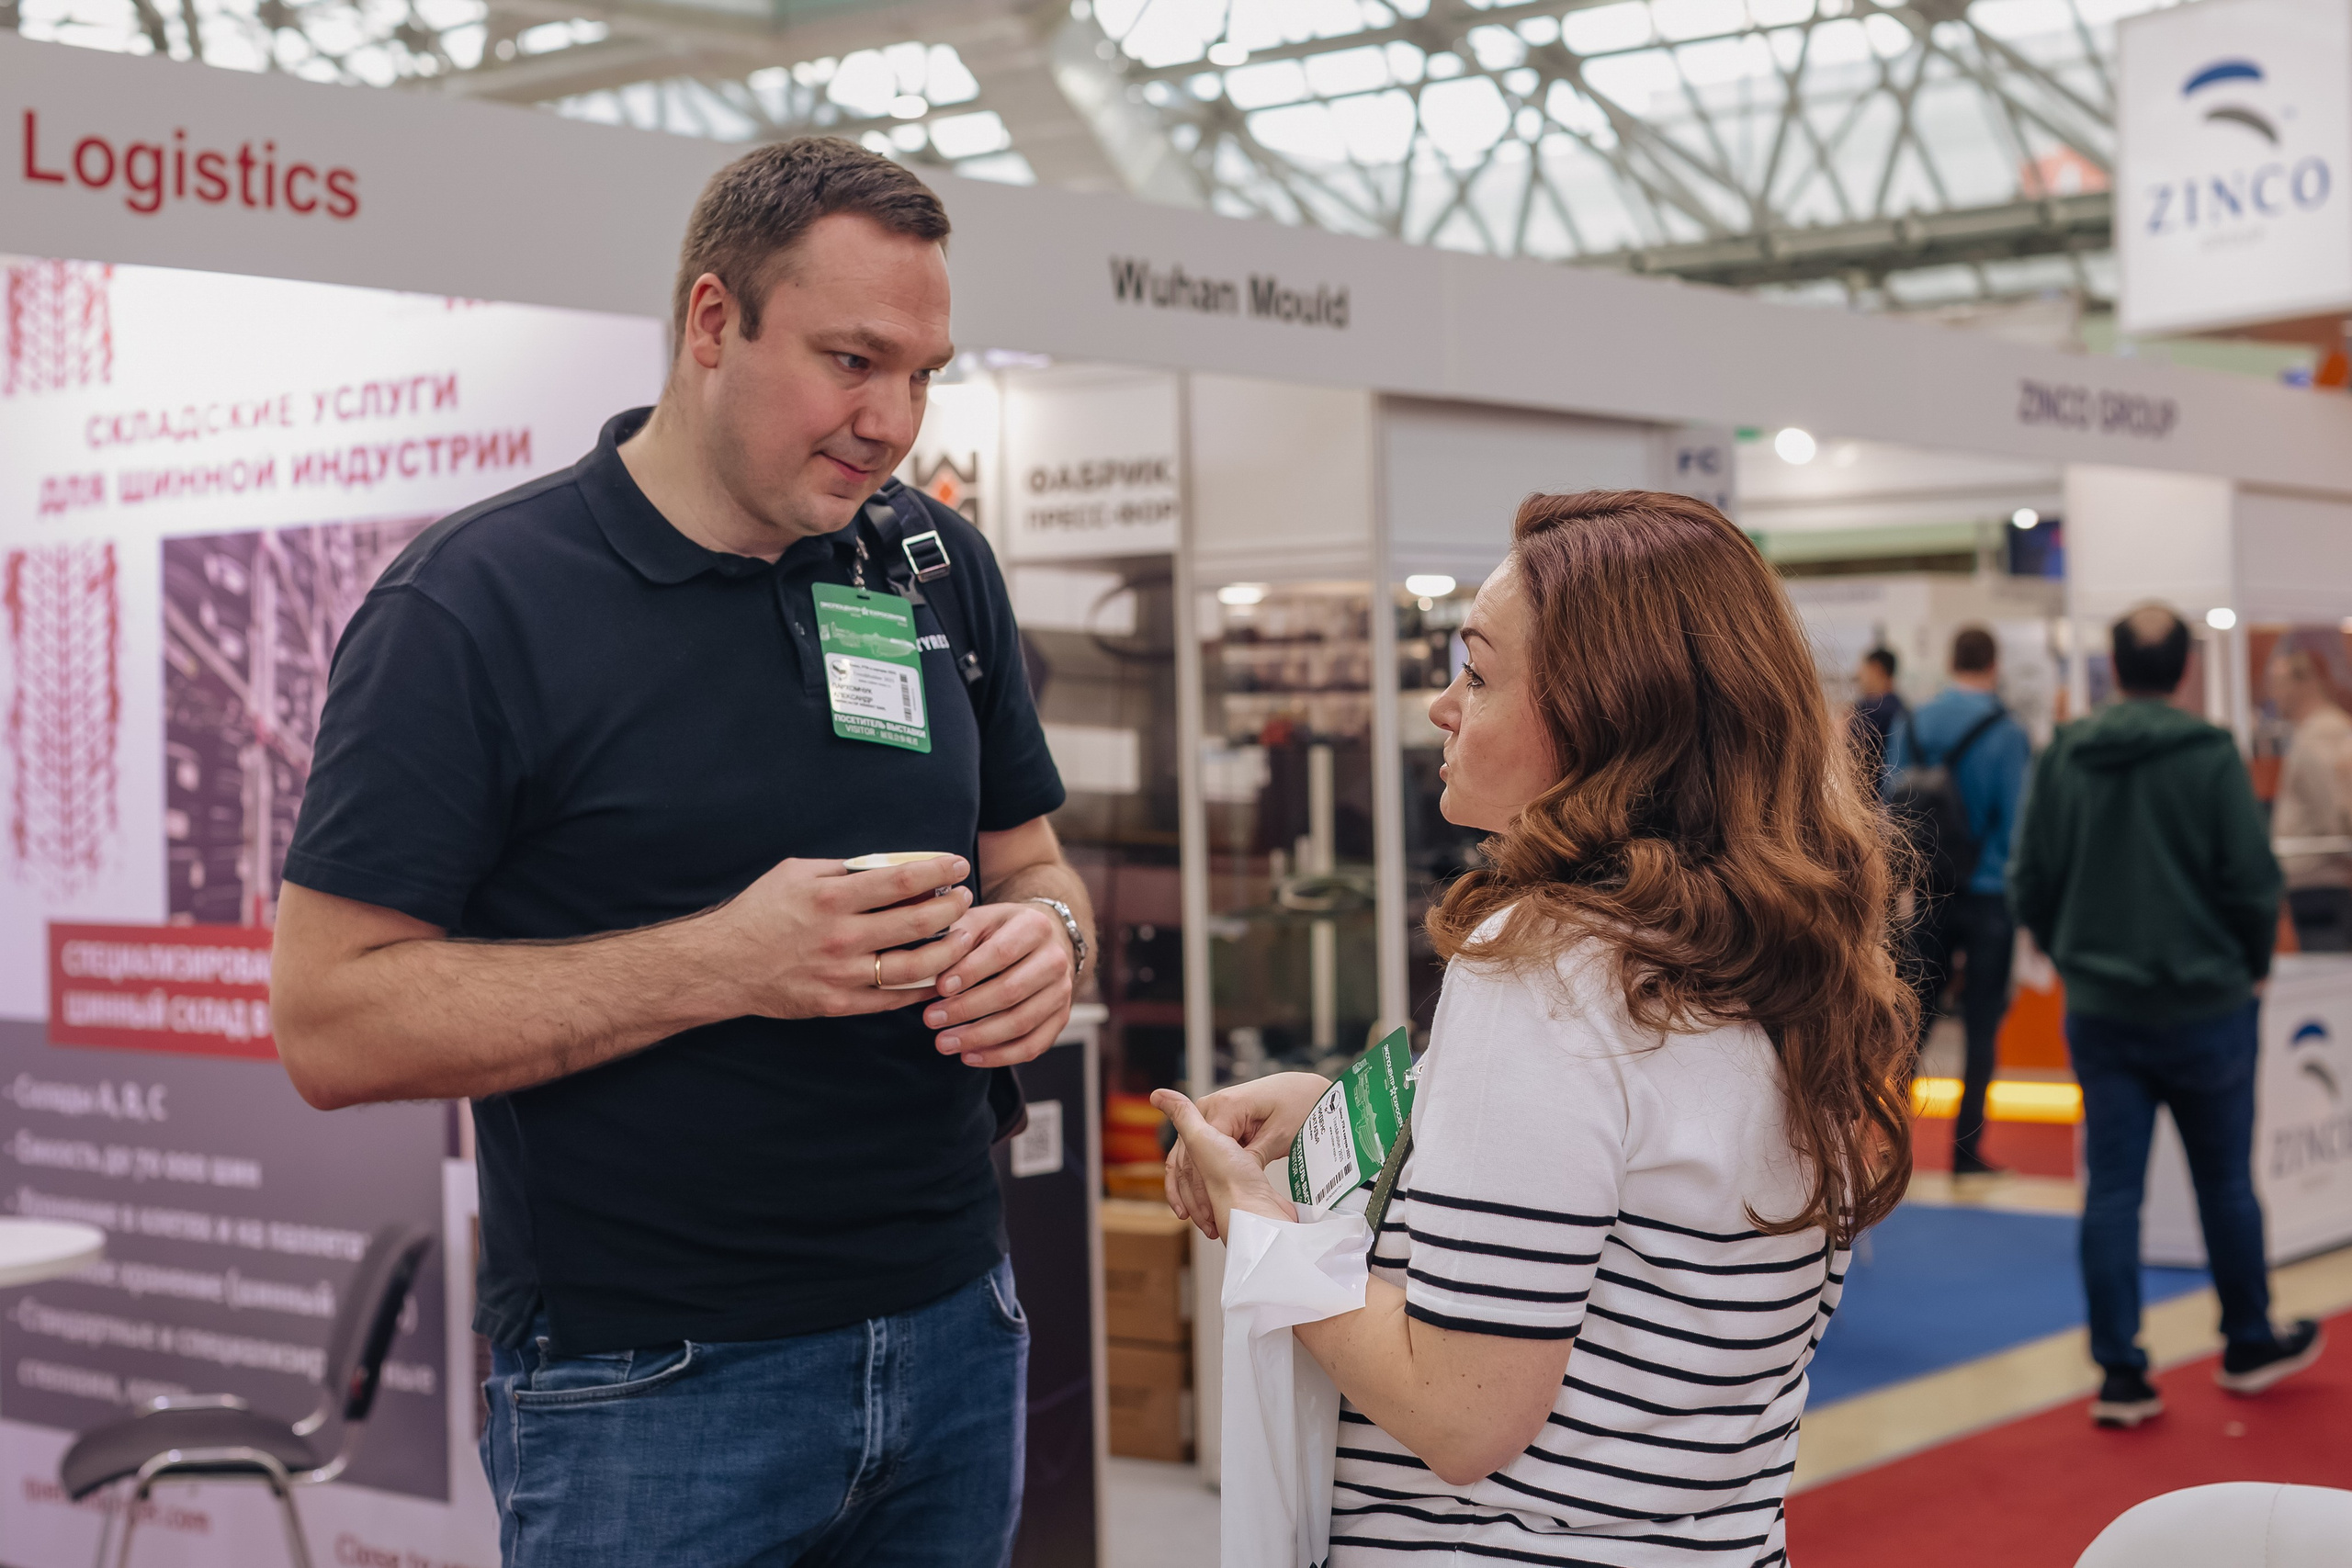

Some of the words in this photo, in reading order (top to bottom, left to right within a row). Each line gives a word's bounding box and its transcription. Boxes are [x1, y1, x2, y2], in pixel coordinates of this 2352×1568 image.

[21, 107, 362, 220] Logistics
[2145, 155, 2332, 235] ZINCO
[1108, 254, 1239, 316] Wuhan
[1247, 272, 1351, 330] Mould
[85, 393, 294, 450] СКЛАДСКИЕ
[312, 372, 460, 425] УСЛУГИ
[39, 472, 106, 518] ДЛЯ
[119, 458, 277, 504] ШИННОЙ
[291, 428, 534, 489] ИНДУСТРИИ
[1027, 460, 1172, 493] ФАБРИК
[1026, 502, 1177, 531] ПРЕСС-ФОР
[833, 713, 887, 730] ПОСЕТИТЕЛЬ
[845, 723, 876, 737] VISITOR
[1392, 1094, 1404, 1128] EXPOCEN
[1301, 1180, 1311, 1205] ВЫСТ
